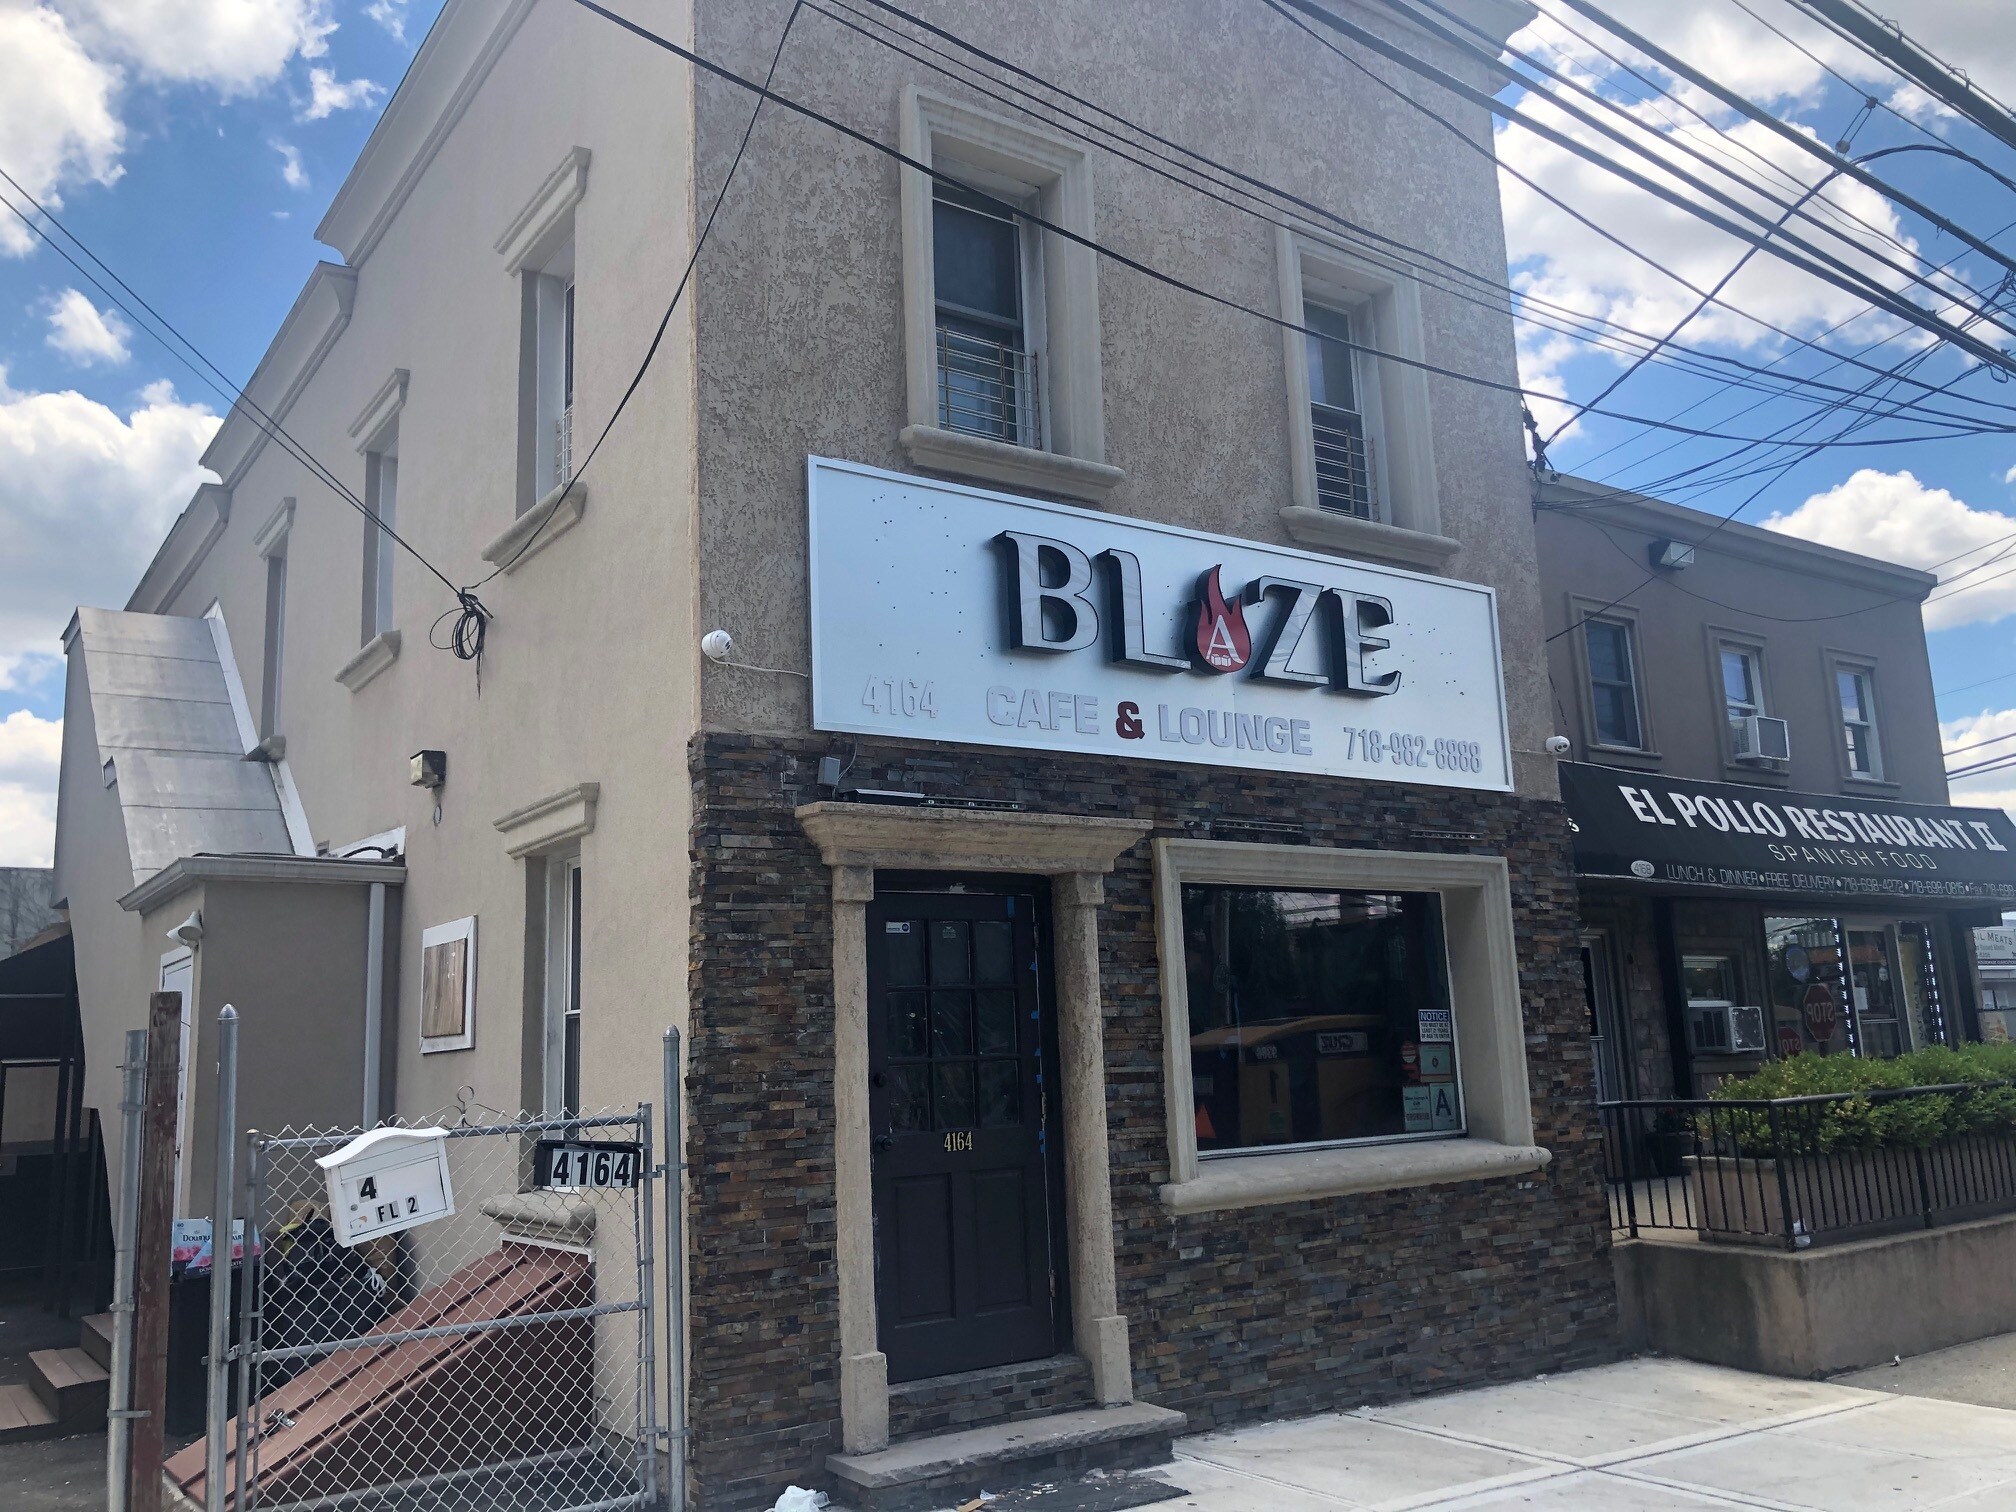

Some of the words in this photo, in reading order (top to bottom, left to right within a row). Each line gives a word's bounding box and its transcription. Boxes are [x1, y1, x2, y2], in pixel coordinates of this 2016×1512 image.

[993, 530, 1402, 698] BLAZE
[862, 674, 938, 718] 4164
[986, 685, 1099, 735] CAFE
[1116, 701, 1145, 740] &
[1158, 703, 1313, 755] LOUNGE
[1343, 726, 1482, 773] 718-982-8888
[1618, 785, 1677, 826] EL
[1667, 792, 1787, 838] POLLO
[1781, 805, 1977, 850] RESTAURANT
[1968, 821, 2007, 851] II
[1768, 843, 1874, 867] SPANISH
[1876, 851, 1937, 869] FOOD
[1665, 863, 1704, 882] LUNCH
[1708, 867, 1717, 883] &
[1420, 1011, 1448, 1021] NOTICE
[1435, 1088, 1452, 1117] A
[944, 1130, 973, 1151] 4164
[552, 1151, 631, 1187] 4164
[360, 1176, 377, 1200] 4
[377, 1205, 398, 1223] FL
[407, 1197, 418, 1213] 2
